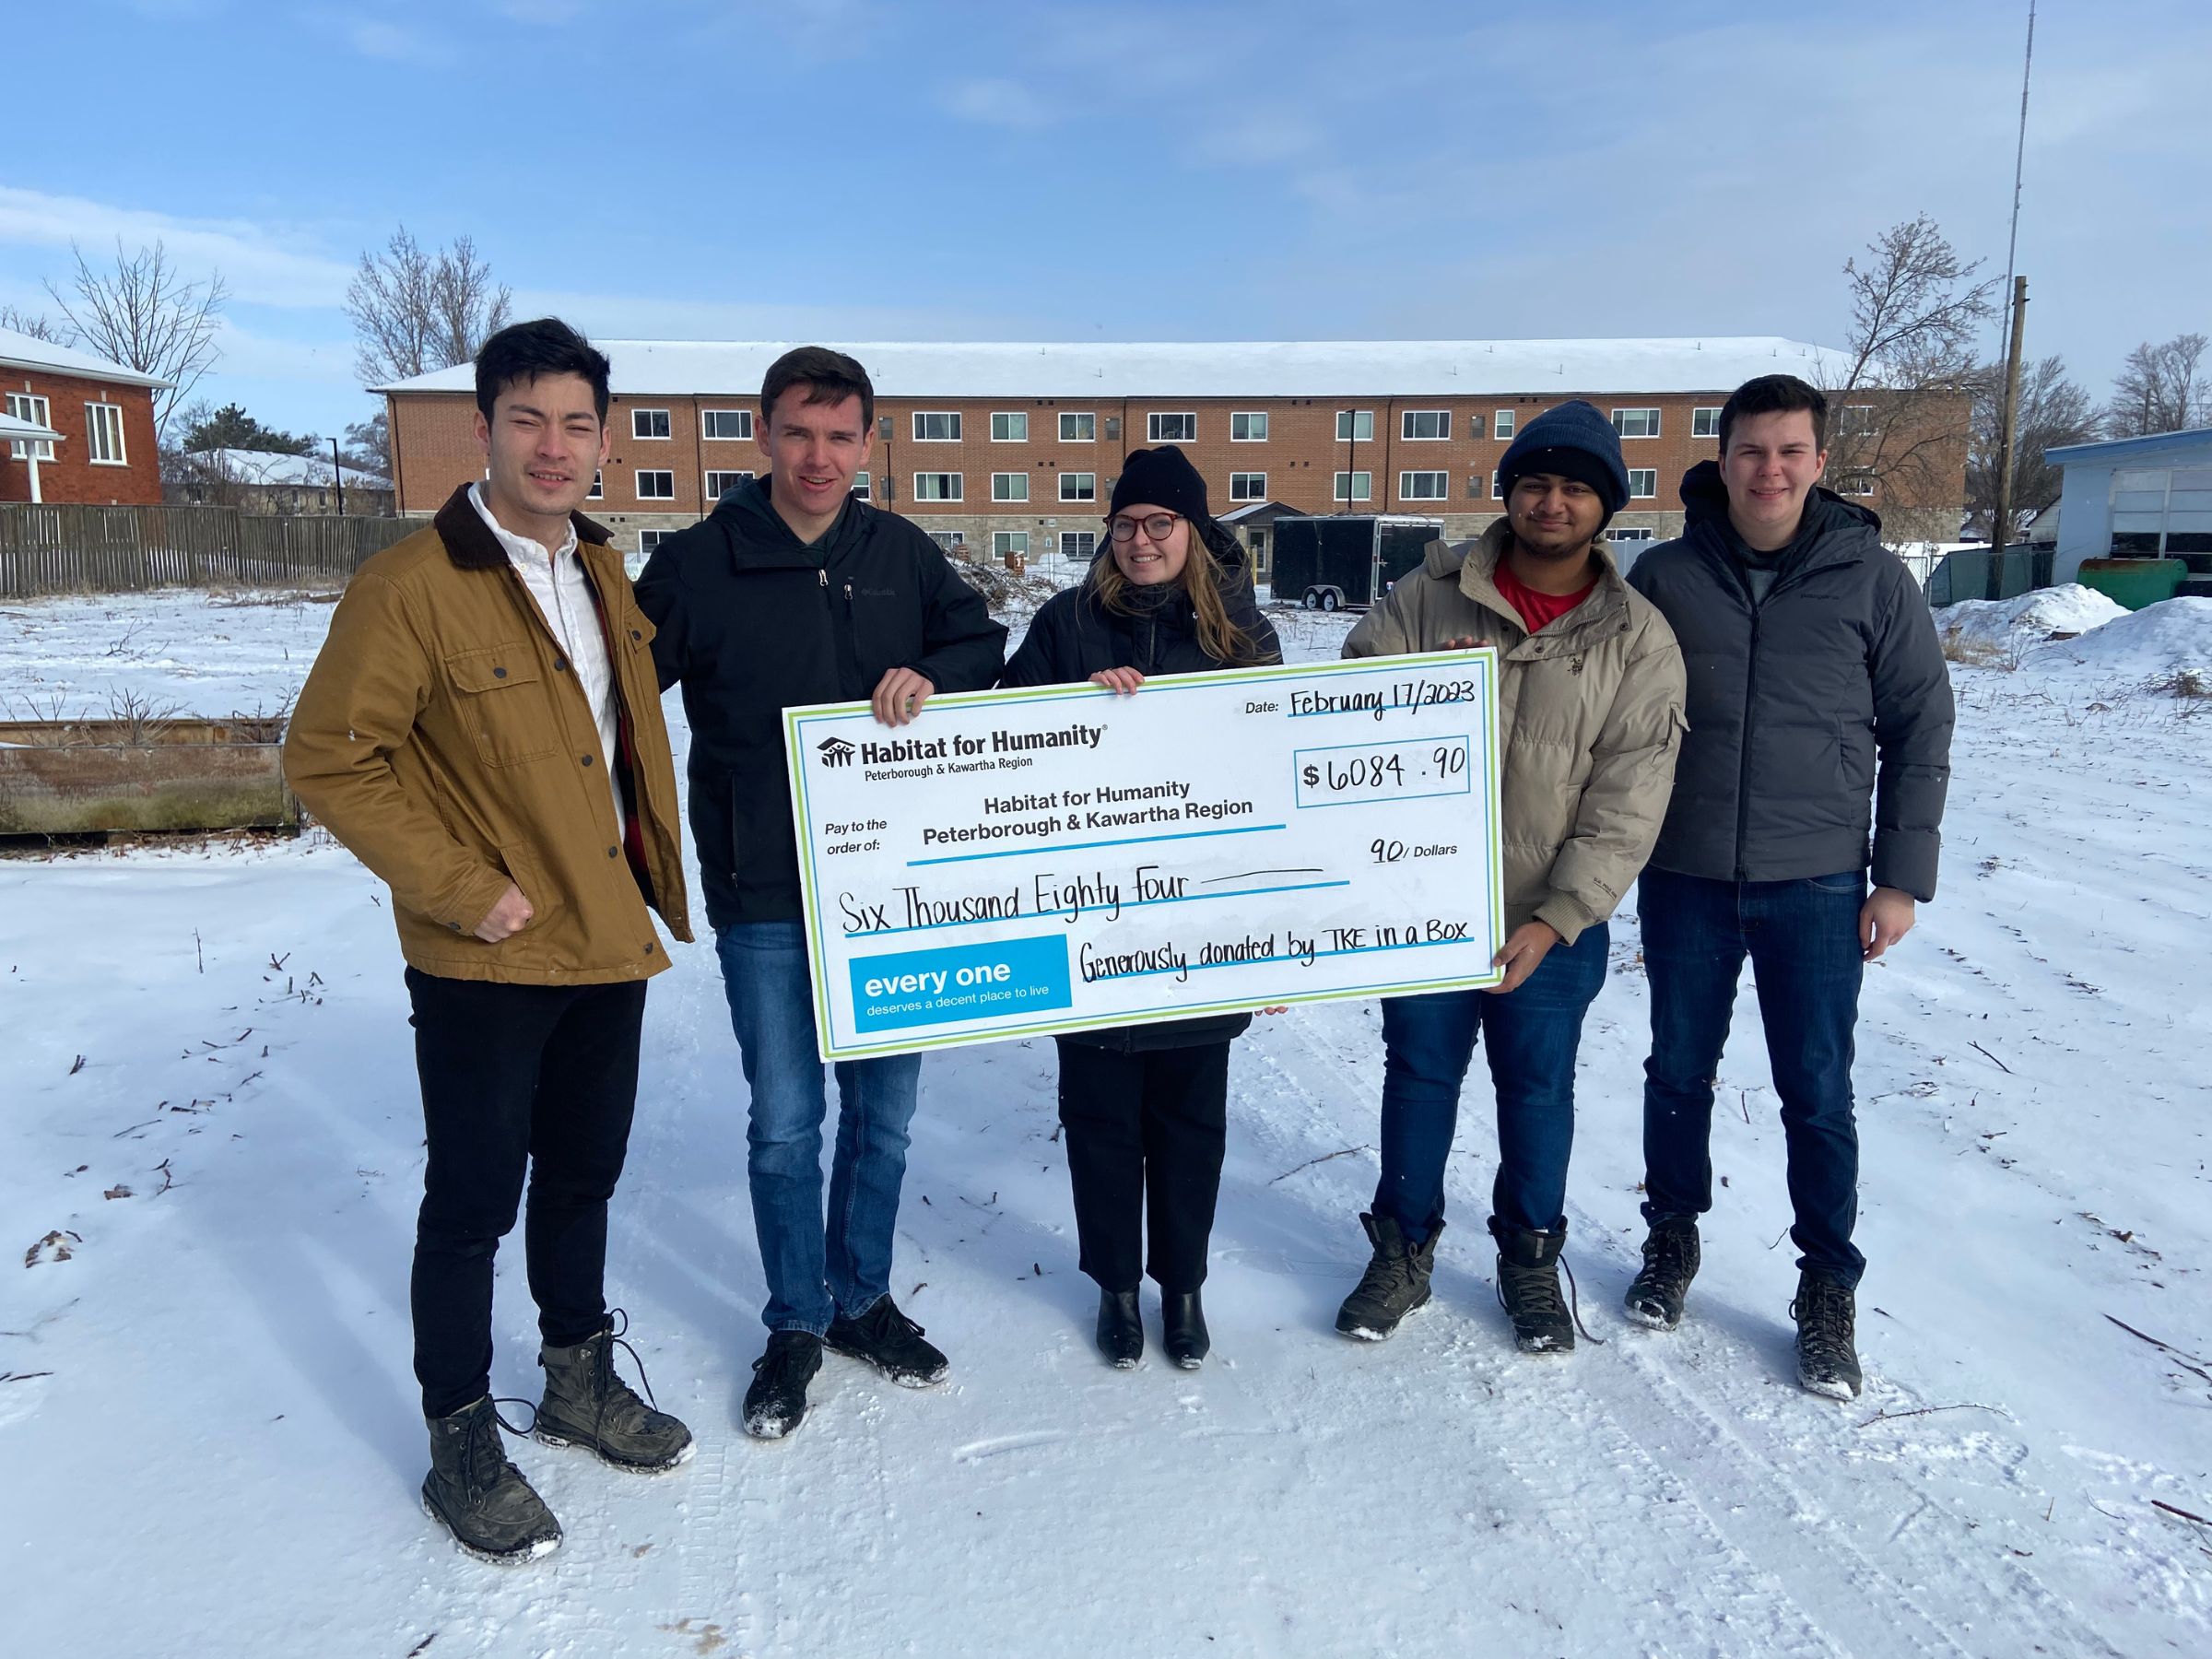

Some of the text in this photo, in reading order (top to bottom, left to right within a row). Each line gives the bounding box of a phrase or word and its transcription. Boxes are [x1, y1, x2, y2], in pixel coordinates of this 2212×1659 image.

[1245, 701, 1279, 714] Date:
[1290, 679, 1476, 722] February 17/2023
[861, 739, 948, 766] Habitat
[952, 734, 986, 757] for
[865, 756, 1033, 782] Peterborough & Kawartha Region
[984, 781, 1191, 815] Habitat for Humanity
[823, 818, 888, 838] Pay to the
[923, 798, 1254, 845] Peterborough & Kawartha Region
[826, 839, 880, 856] order of:
[1413, 844, 1458, 858] Dollars
[839, 865, 1190, 933] Six Thousand Eighty Four
[1079, 919, 1468, 983] Generously donated by TKE in a Box
[865, 963, 1011, 997] every one
[865, 984, 1050, 1017] deserves a decent place to live
